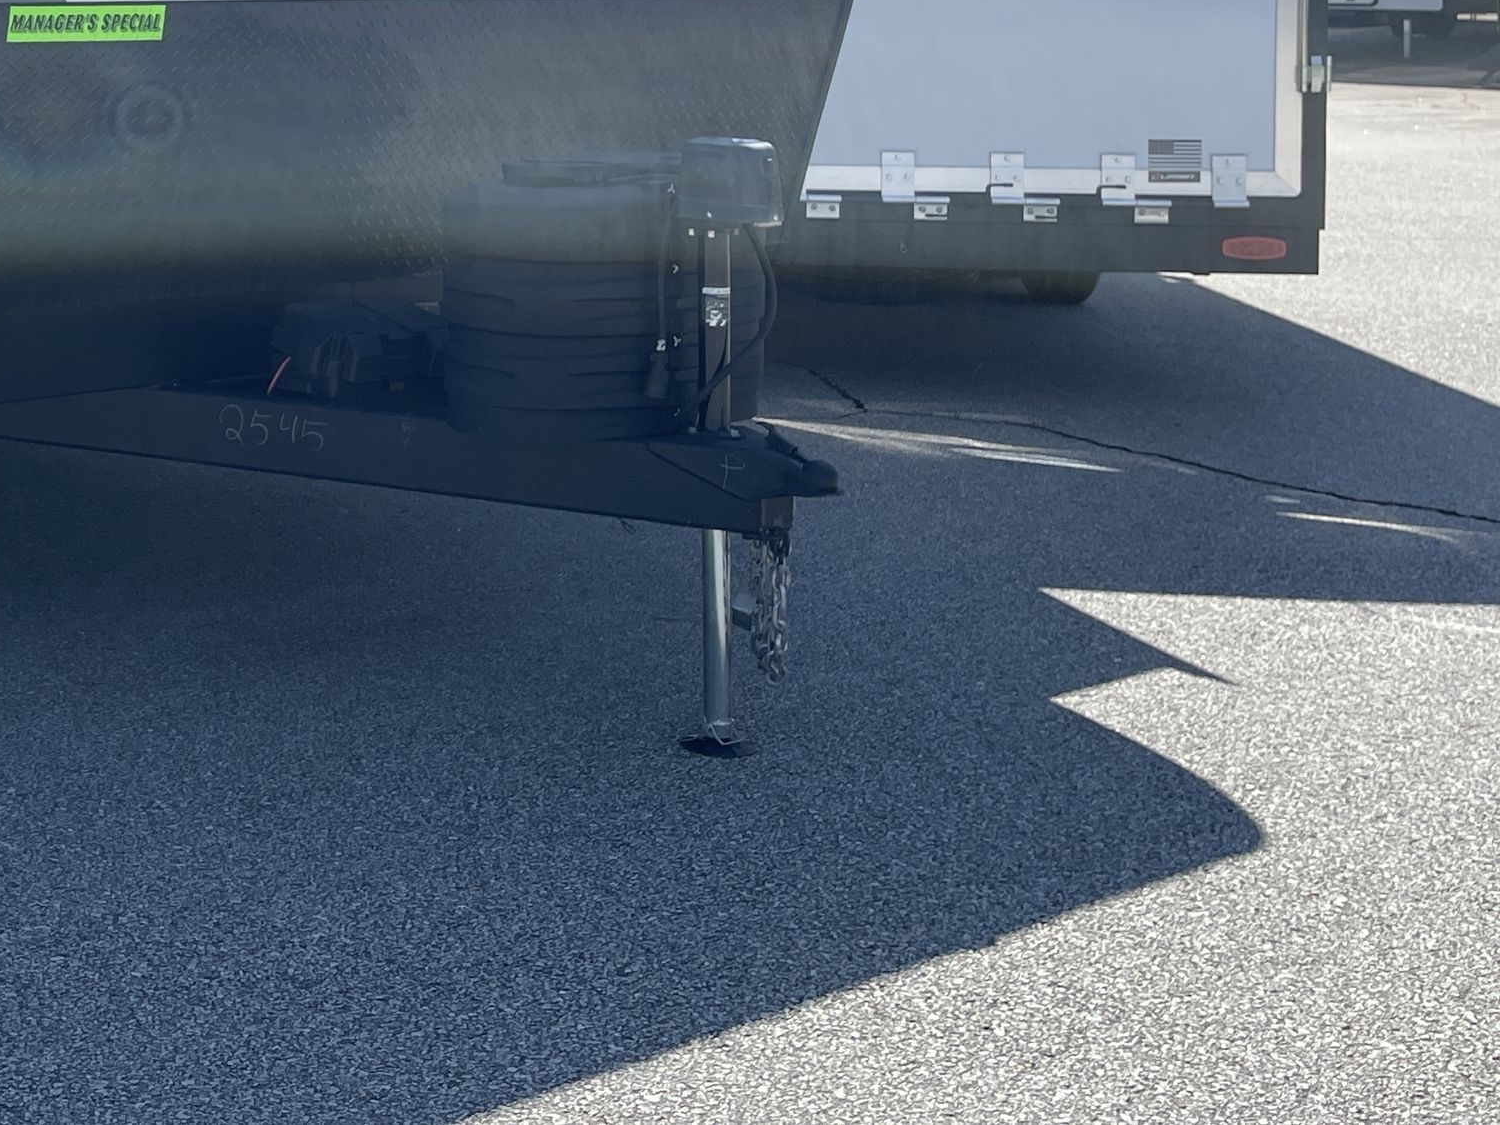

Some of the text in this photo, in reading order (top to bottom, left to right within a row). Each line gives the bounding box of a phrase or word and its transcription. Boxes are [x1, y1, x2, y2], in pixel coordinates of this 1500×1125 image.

[10, 12, 162, 34] MANAGER'S SPECIAL
[219, 403, 328, 452] 2545
